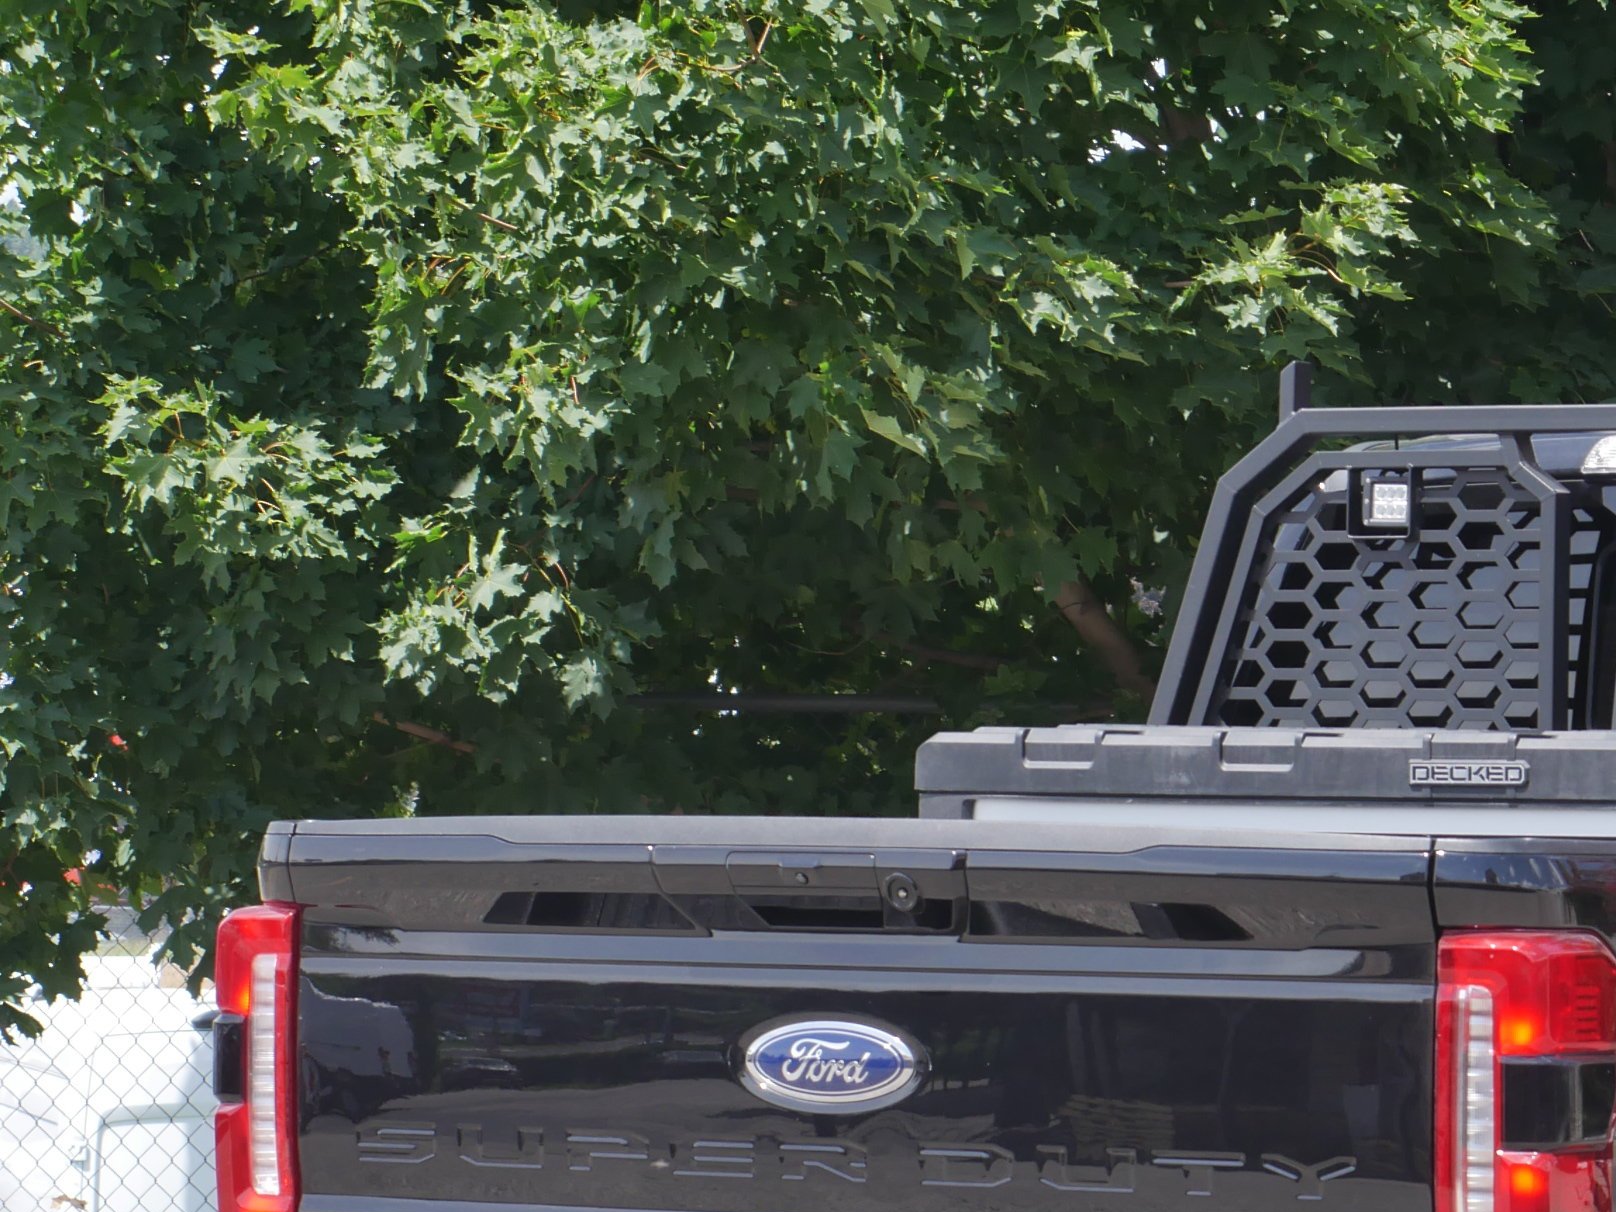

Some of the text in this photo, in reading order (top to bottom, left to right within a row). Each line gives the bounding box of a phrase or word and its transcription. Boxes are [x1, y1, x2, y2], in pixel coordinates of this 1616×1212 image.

[1412, 765, 1522, 782] DECKED
[781, 1038, 871, 1084] Ford
[356, 1121, 1356, 1200] SUPER DUTY
